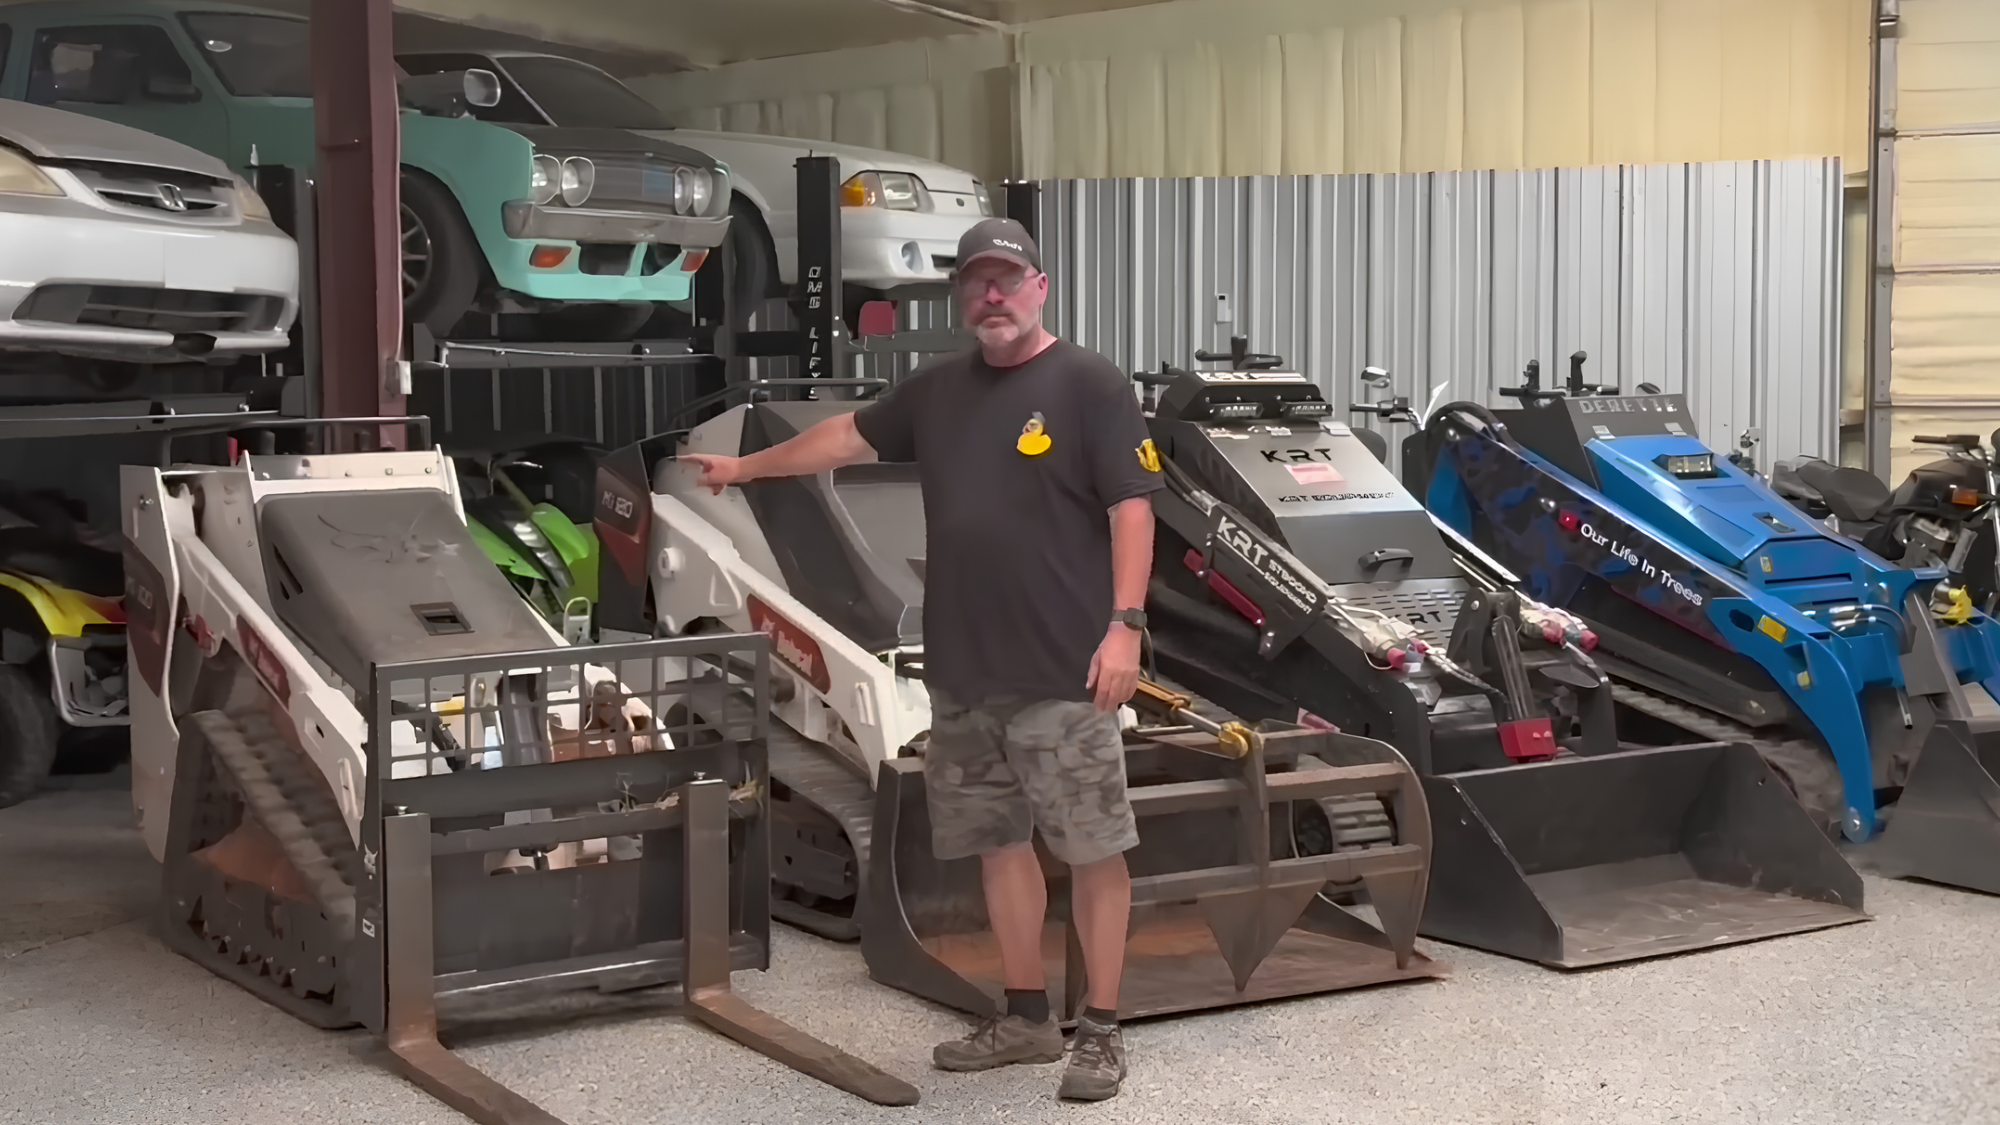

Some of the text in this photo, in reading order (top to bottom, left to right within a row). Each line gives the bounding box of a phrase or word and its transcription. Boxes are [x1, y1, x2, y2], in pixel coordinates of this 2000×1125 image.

[1260, 448, 1332, 463] KRT
[1217, 515, 1270, 566] KRT
[1580, 523, 1703, 606] Our Life In Trees
